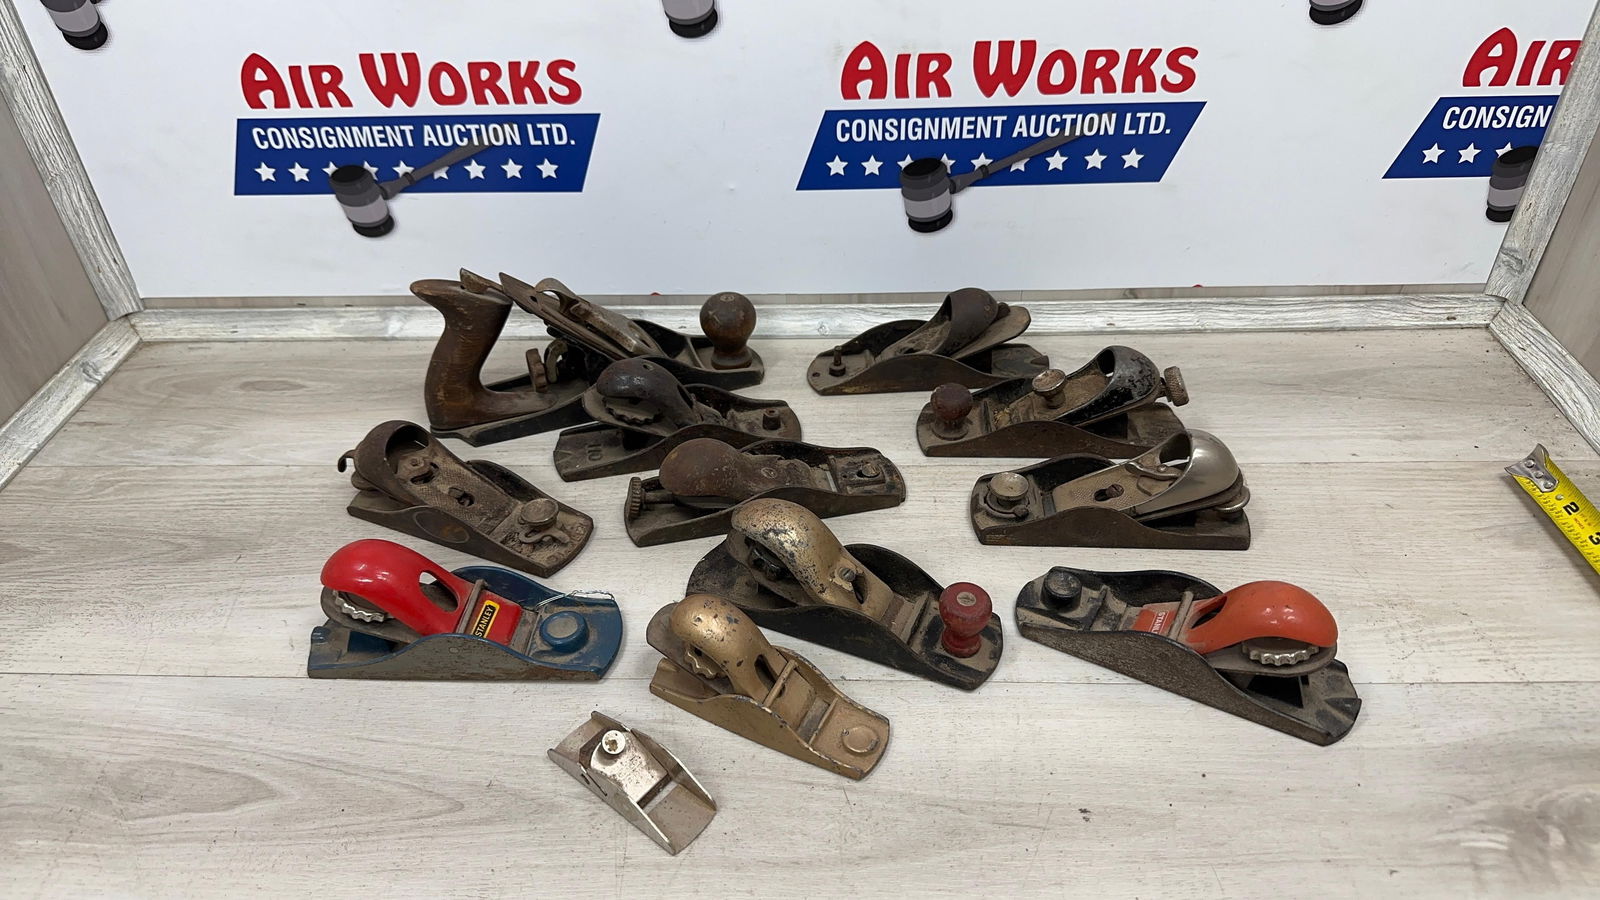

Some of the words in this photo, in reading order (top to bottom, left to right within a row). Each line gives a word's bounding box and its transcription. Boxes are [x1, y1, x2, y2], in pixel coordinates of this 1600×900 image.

[241, 53, 353, 109] AIR
[359, 52, 582, 108] WORKS
[841, 40, 953, 100] AIR
[973, 39, 1198, 97] WORKS
[836, 115, 1007, 142] CONSIGNMENT
[1012, 112, 1117, 139] AUCTION
[1123, 112, 1172, 136] LTD.
[1442, 105, 1553, 129] CONSIGN
[252, 126, 414, 150] CONSIGNMENT
[423, 123, 522, 147] AUCTION
[529, 123, 576, 146] LTD.
[1563, 501, 1580, 516] 2
[475, 605, 494, 638] STANLEY
